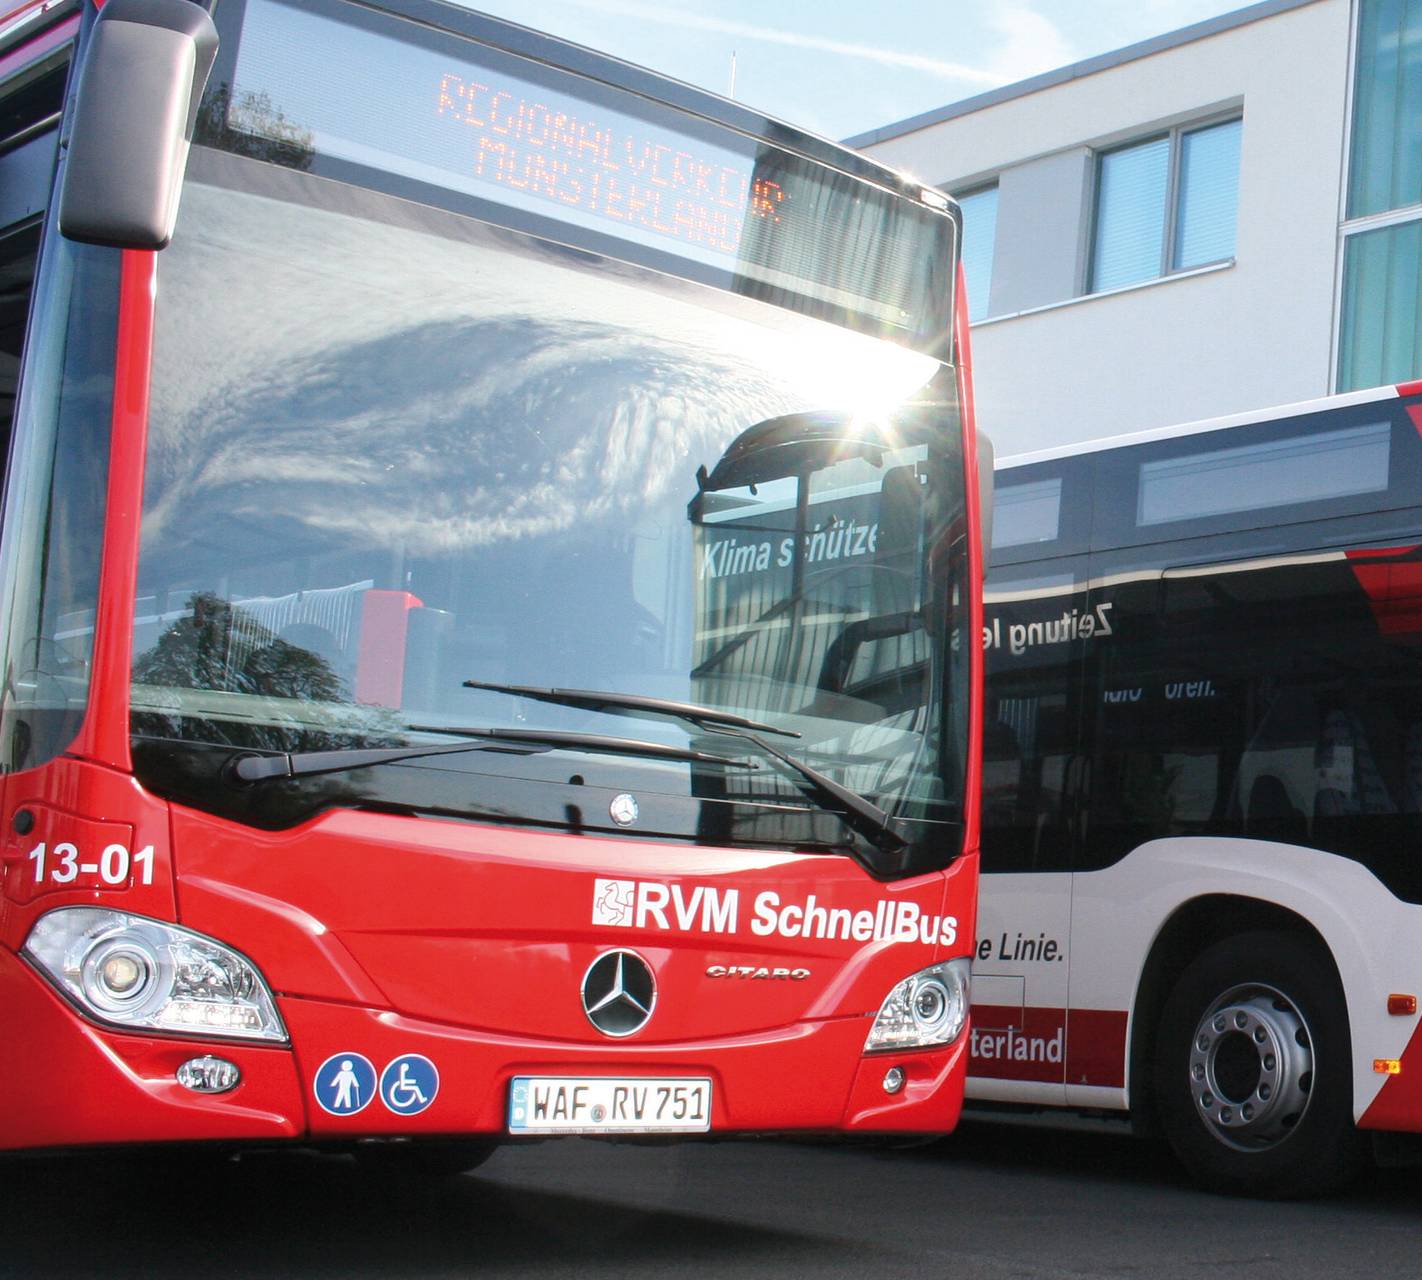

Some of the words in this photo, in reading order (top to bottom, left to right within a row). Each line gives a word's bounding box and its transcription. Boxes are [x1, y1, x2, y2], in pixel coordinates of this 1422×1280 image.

[700, 539, 772, 580] Klima
[28, 842, 155, 885] 13-01
[636, 882, 739, 934] RVM
[751, 891, 958, 946] SchnellBus
[999, 933, 1063, 962] Linie.
[706, 965, 811, 980] CITARO
[534, 1086, 589, 1120] WAF
